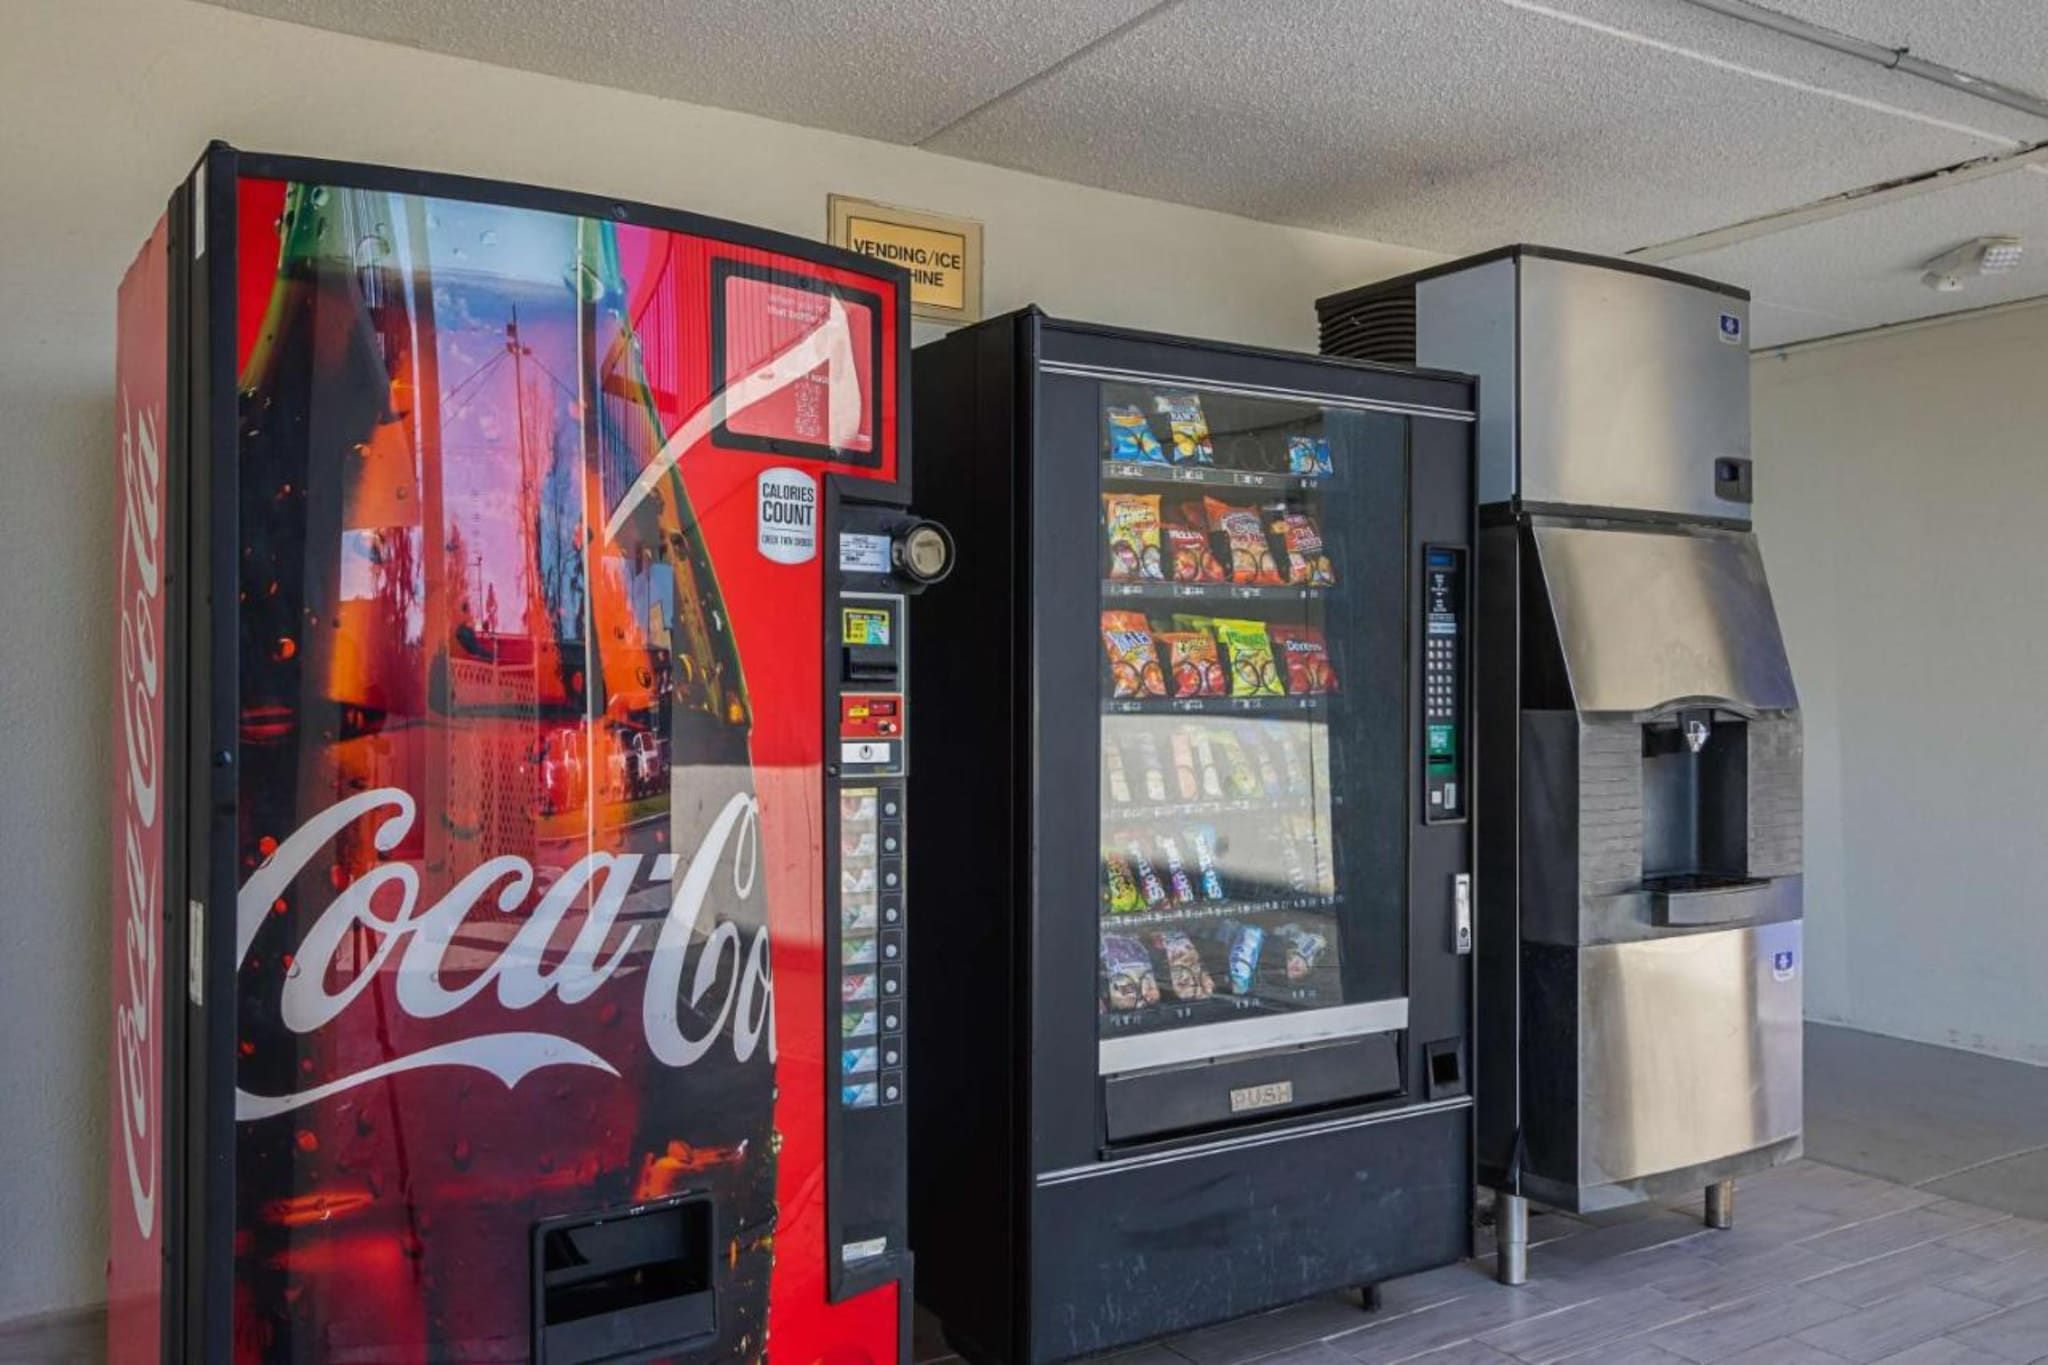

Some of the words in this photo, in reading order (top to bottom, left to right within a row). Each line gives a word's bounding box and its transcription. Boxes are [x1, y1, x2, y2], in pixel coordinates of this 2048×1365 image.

[854, 239, 961, 270] VENDING/ICE
[909, 269, 944, 287] HINE
[762, 482, 815, 503] CALORIES
[762, 500, 815, 526] COUNT
[117, 384, 159, 1238] Coca-Cola
[236, 788, 777, 1121] Coca-Co
[1233, 1084, 1290, 1107] PUSH
